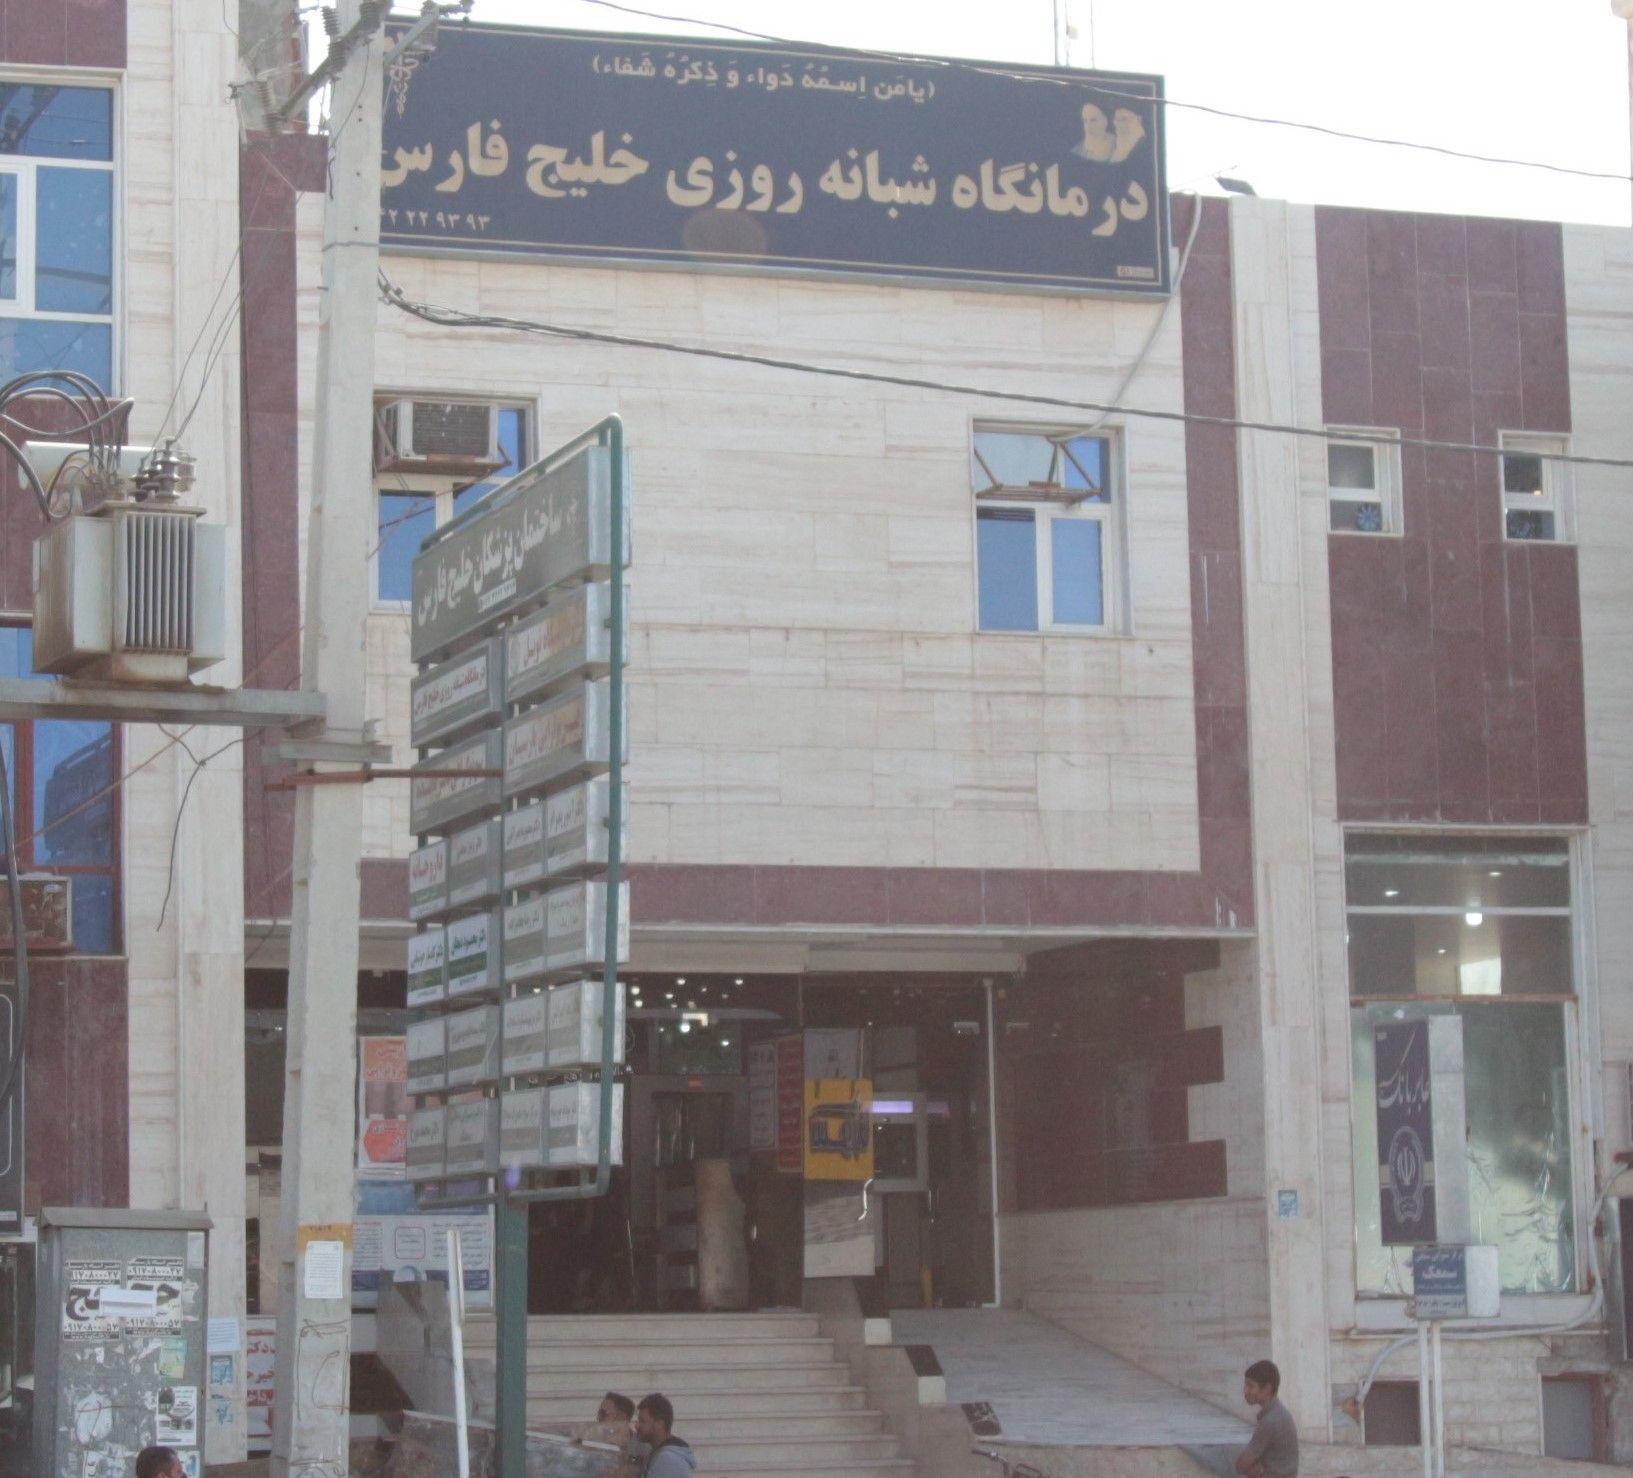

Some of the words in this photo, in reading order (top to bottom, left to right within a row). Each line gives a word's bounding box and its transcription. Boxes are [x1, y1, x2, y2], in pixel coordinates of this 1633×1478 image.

[381, 118, 509, 194] فارس
[525, 129, 650, 199] خلیج
[665, 149, 804, 214] روزی
[818, 147, 937, 220] شبانه
[951, 158, 1149, 237] درمانگاه
